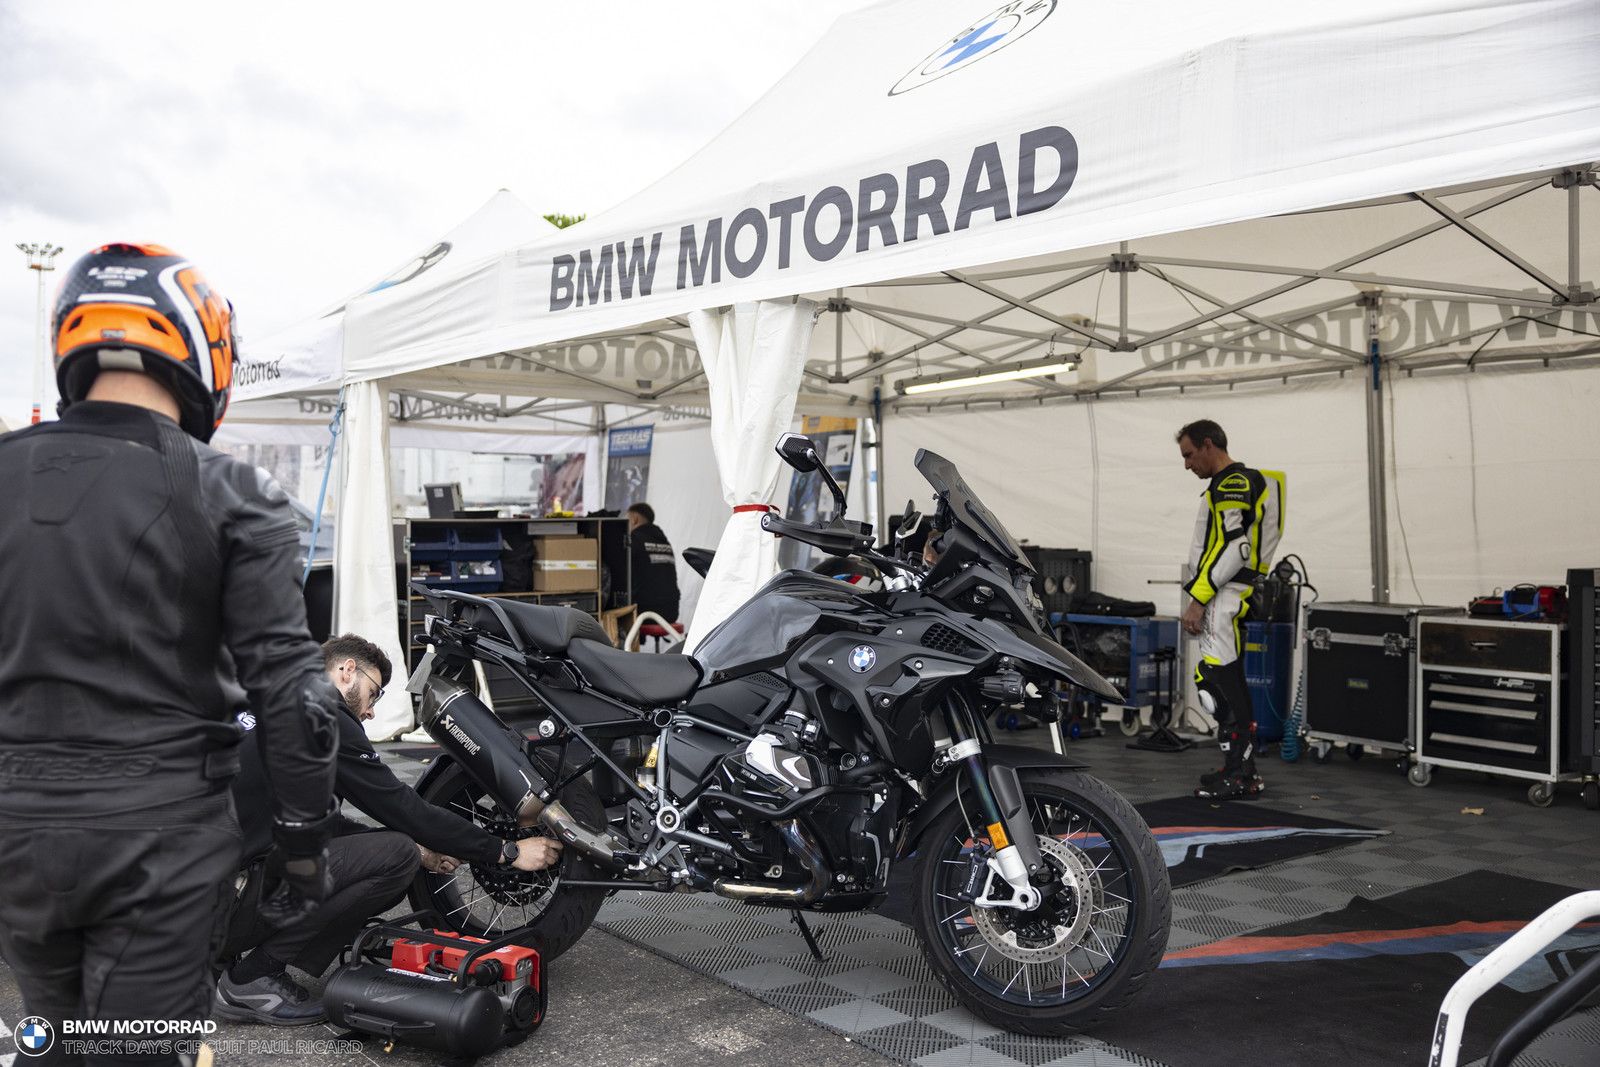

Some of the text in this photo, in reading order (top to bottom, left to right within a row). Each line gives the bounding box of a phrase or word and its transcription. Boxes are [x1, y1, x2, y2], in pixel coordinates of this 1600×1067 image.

[549, 126, 1079, 312] BMW MOTORRAD
[855, 646, 875, 658] BMW
